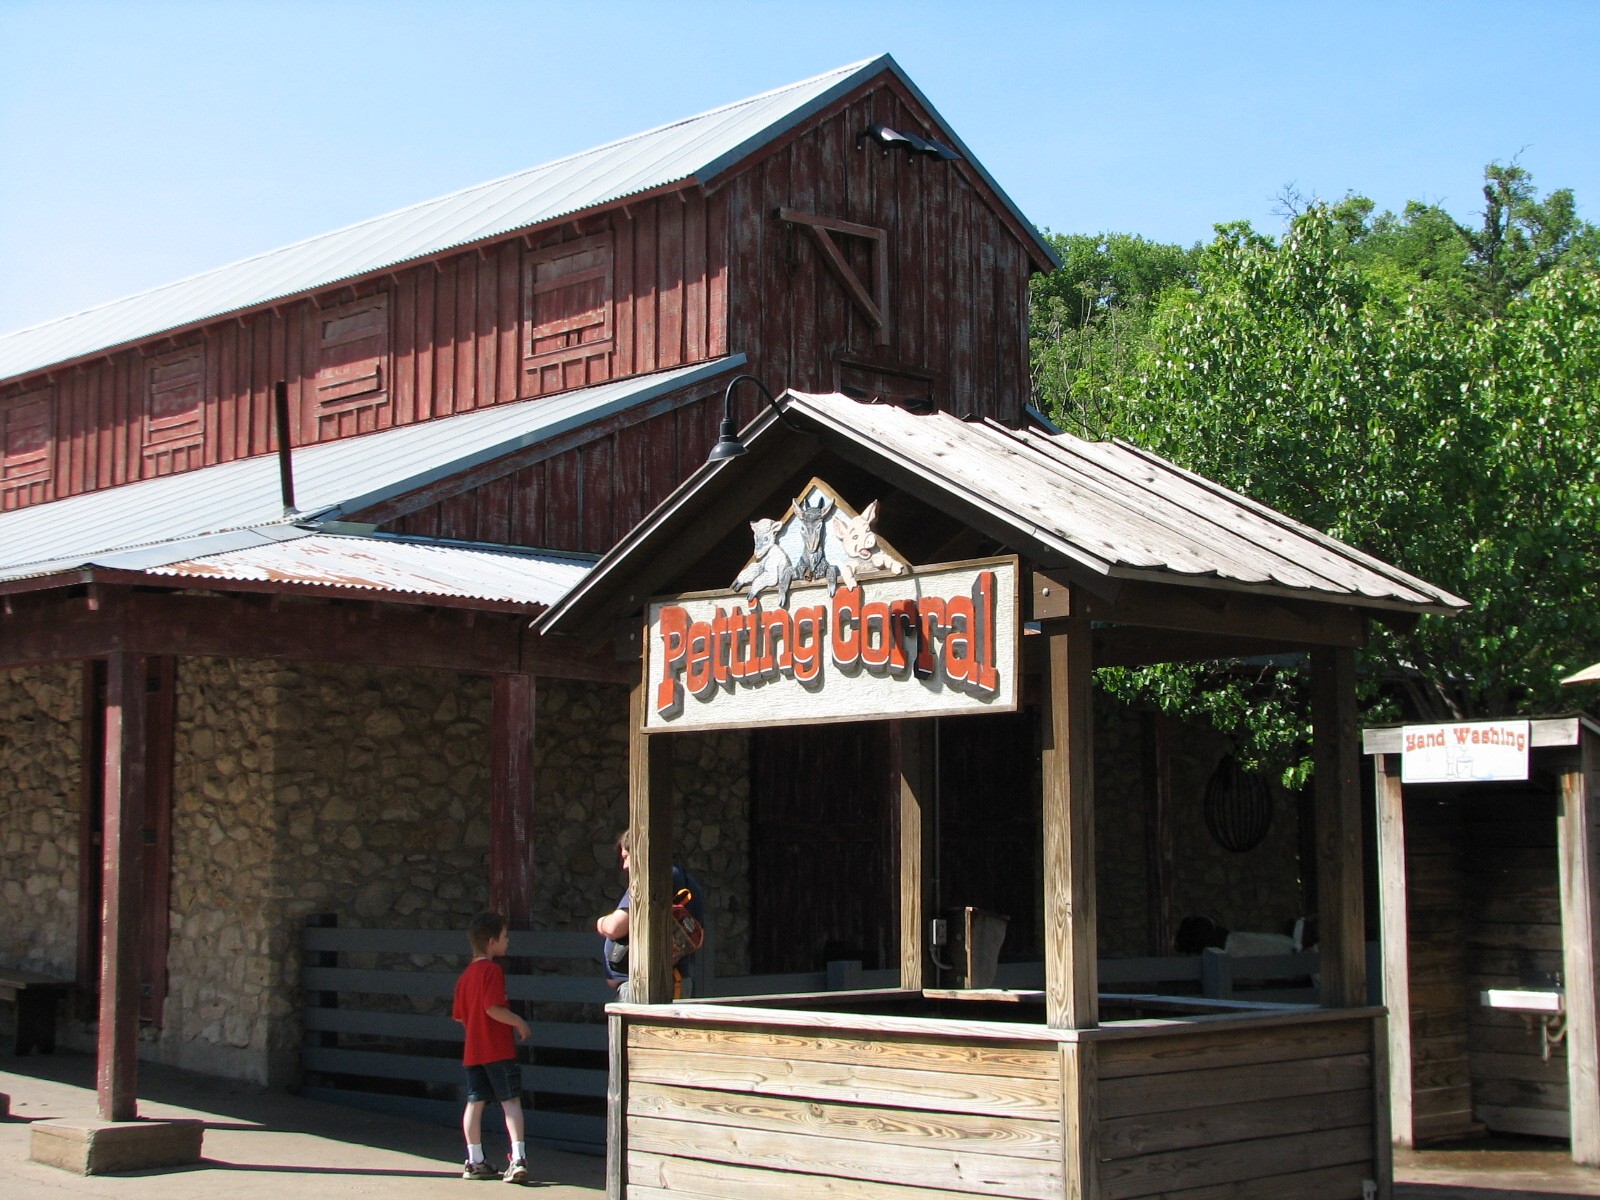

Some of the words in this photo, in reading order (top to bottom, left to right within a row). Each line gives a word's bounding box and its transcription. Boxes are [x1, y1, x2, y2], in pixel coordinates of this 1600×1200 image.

[657, 597, 826, 720] Petting
[832, 571, 998, 696] Corral
[1406, 729, 1445, 752] Hand
[1453, 727, 1525, 751] Washing
